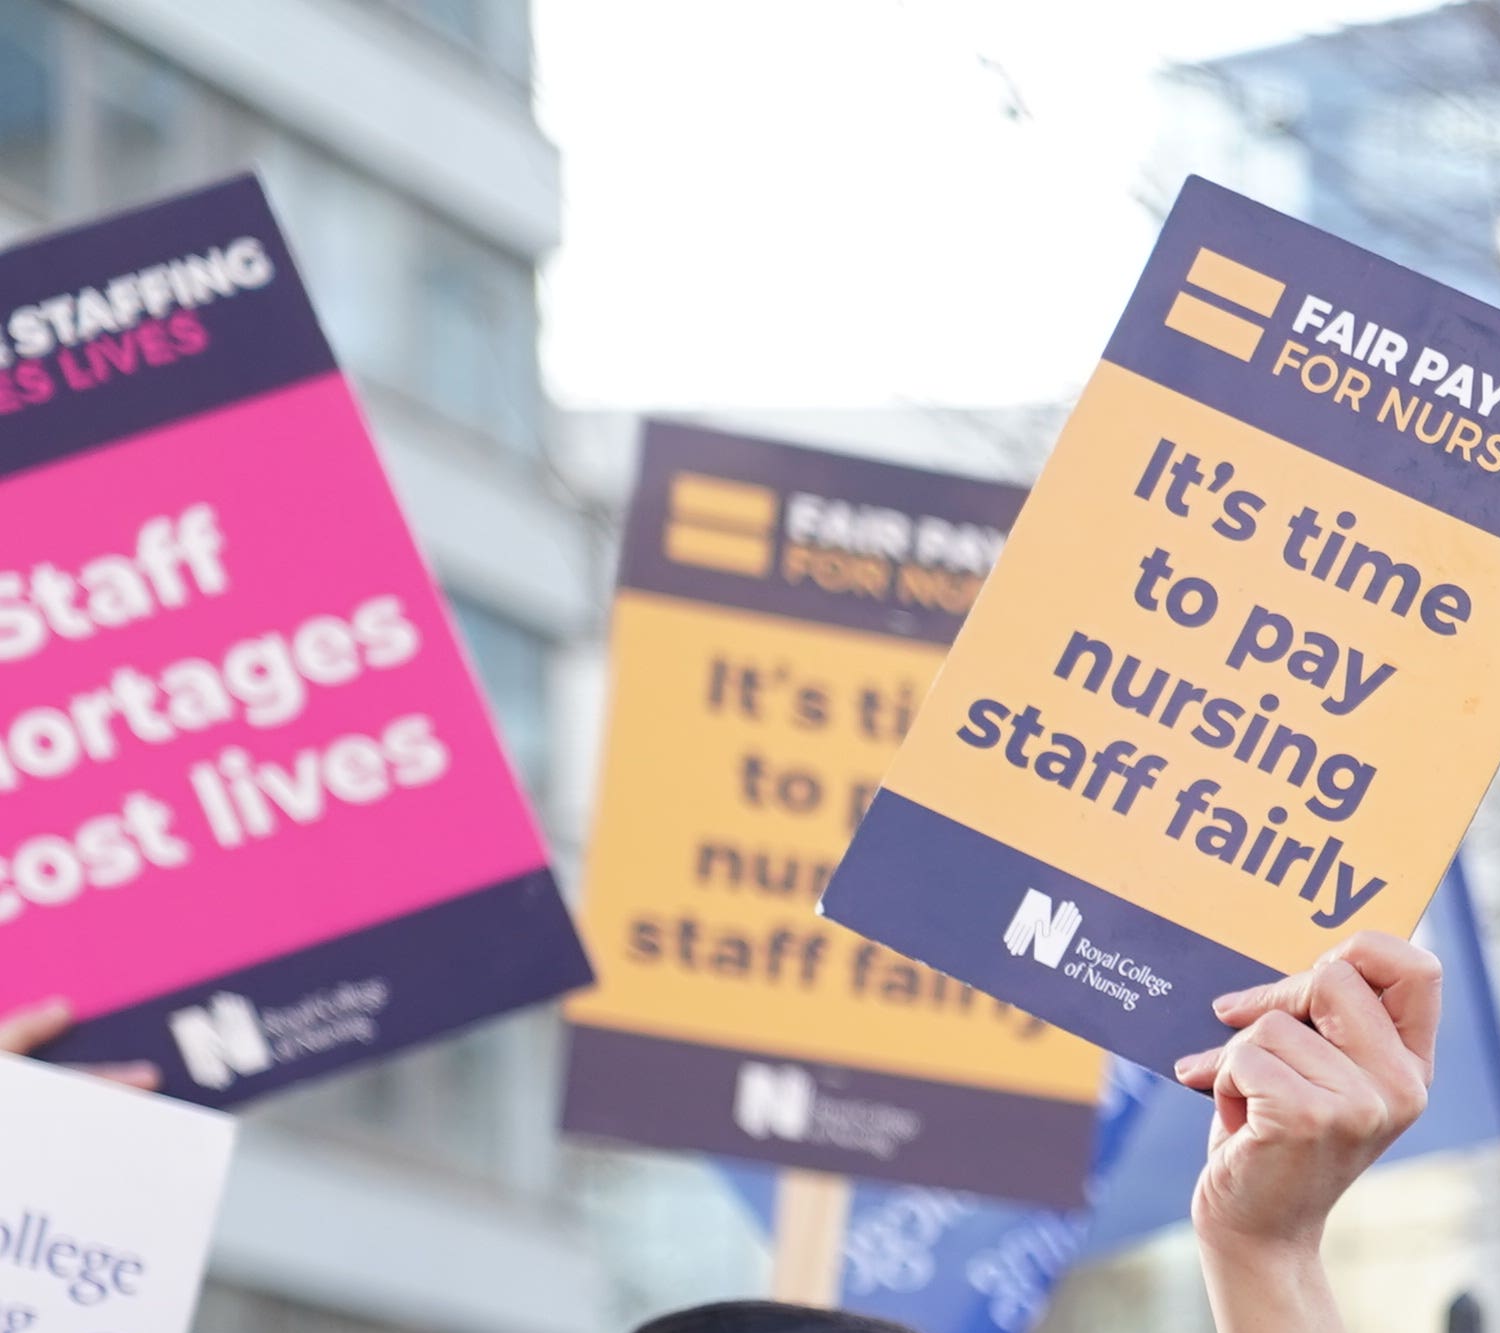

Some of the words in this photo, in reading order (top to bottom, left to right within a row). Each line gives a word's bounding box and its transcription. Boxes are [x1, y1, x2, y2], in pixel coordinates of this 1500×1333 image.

[8, 236, 274, 359] STAFFING
[1293, 294, 1409, 375] FAIR
[57, 308, 208, 391] LIVES
[1271, 341, 1372, 413] FOR
[786, 490, 913, 562] FAIR
[1281, 497, 1473, 637] time
[1133, 547, 1218, 629] to
[1225, 603, 1398, 717] pay
[1053, 631, 1378, 823] nursing
[190, 713, 448, 850] lives
[739, 750, 824, 816] to
[956, 698, 1168, 815] staff
[1165, 779, 1389, 930] fairly
[628, 915, 829, 988] staff
[1064, 962, 1087, 979] of
[1082, 967, 1140, 1011] Nursing
[1075, 937, 1120, 970] Royal
[1118, 958, 1173, 997] College
